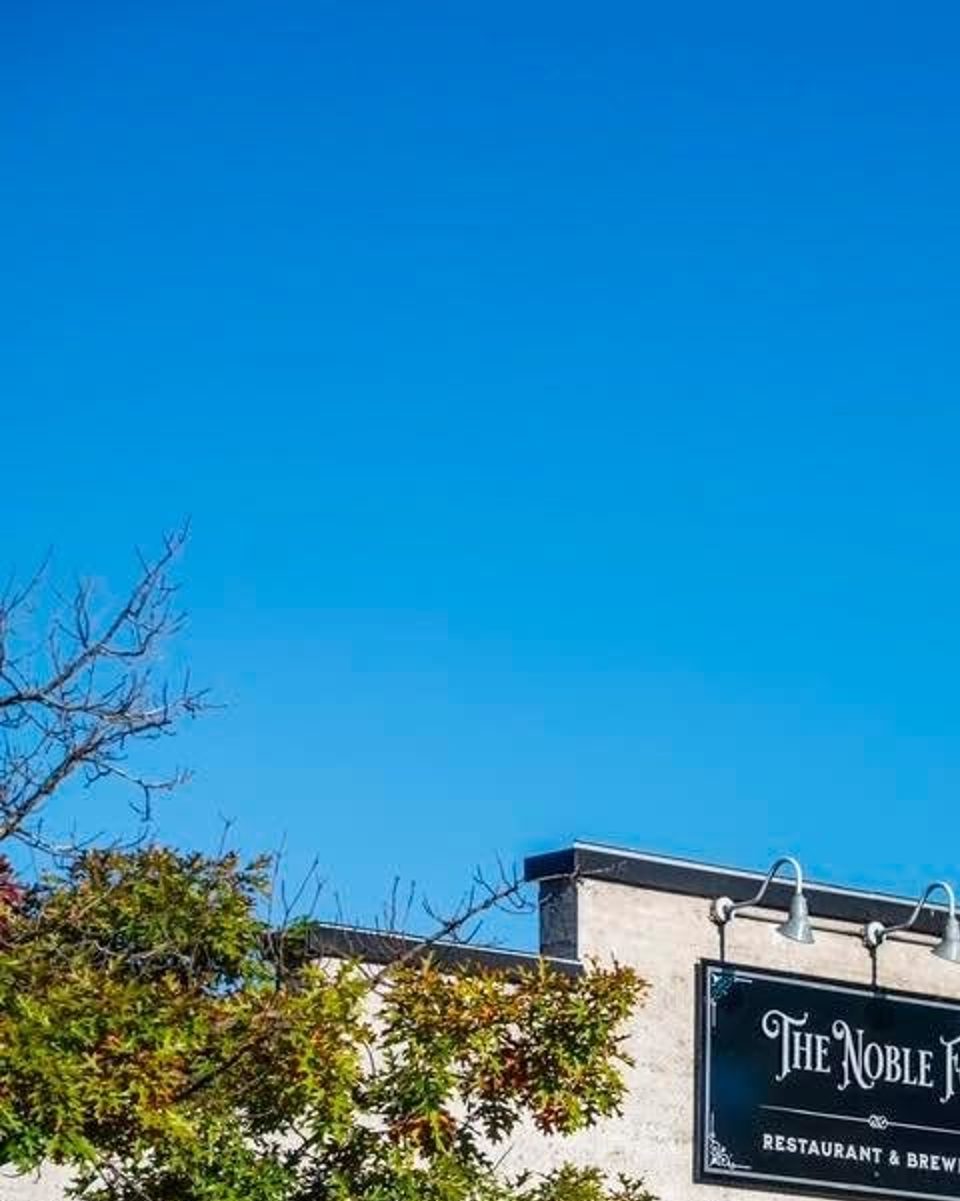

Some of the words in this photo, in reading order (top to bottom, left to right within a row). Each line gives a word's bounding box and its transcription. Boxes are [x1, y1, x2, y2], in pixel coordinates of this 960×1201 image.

[761, 1009, 831, 1082] THE
[831, 1019, 934, 1091] NOBLE
[763, 1133, 883, 1165] RESTAURANT
[889, 1149, 901, 1166] &
